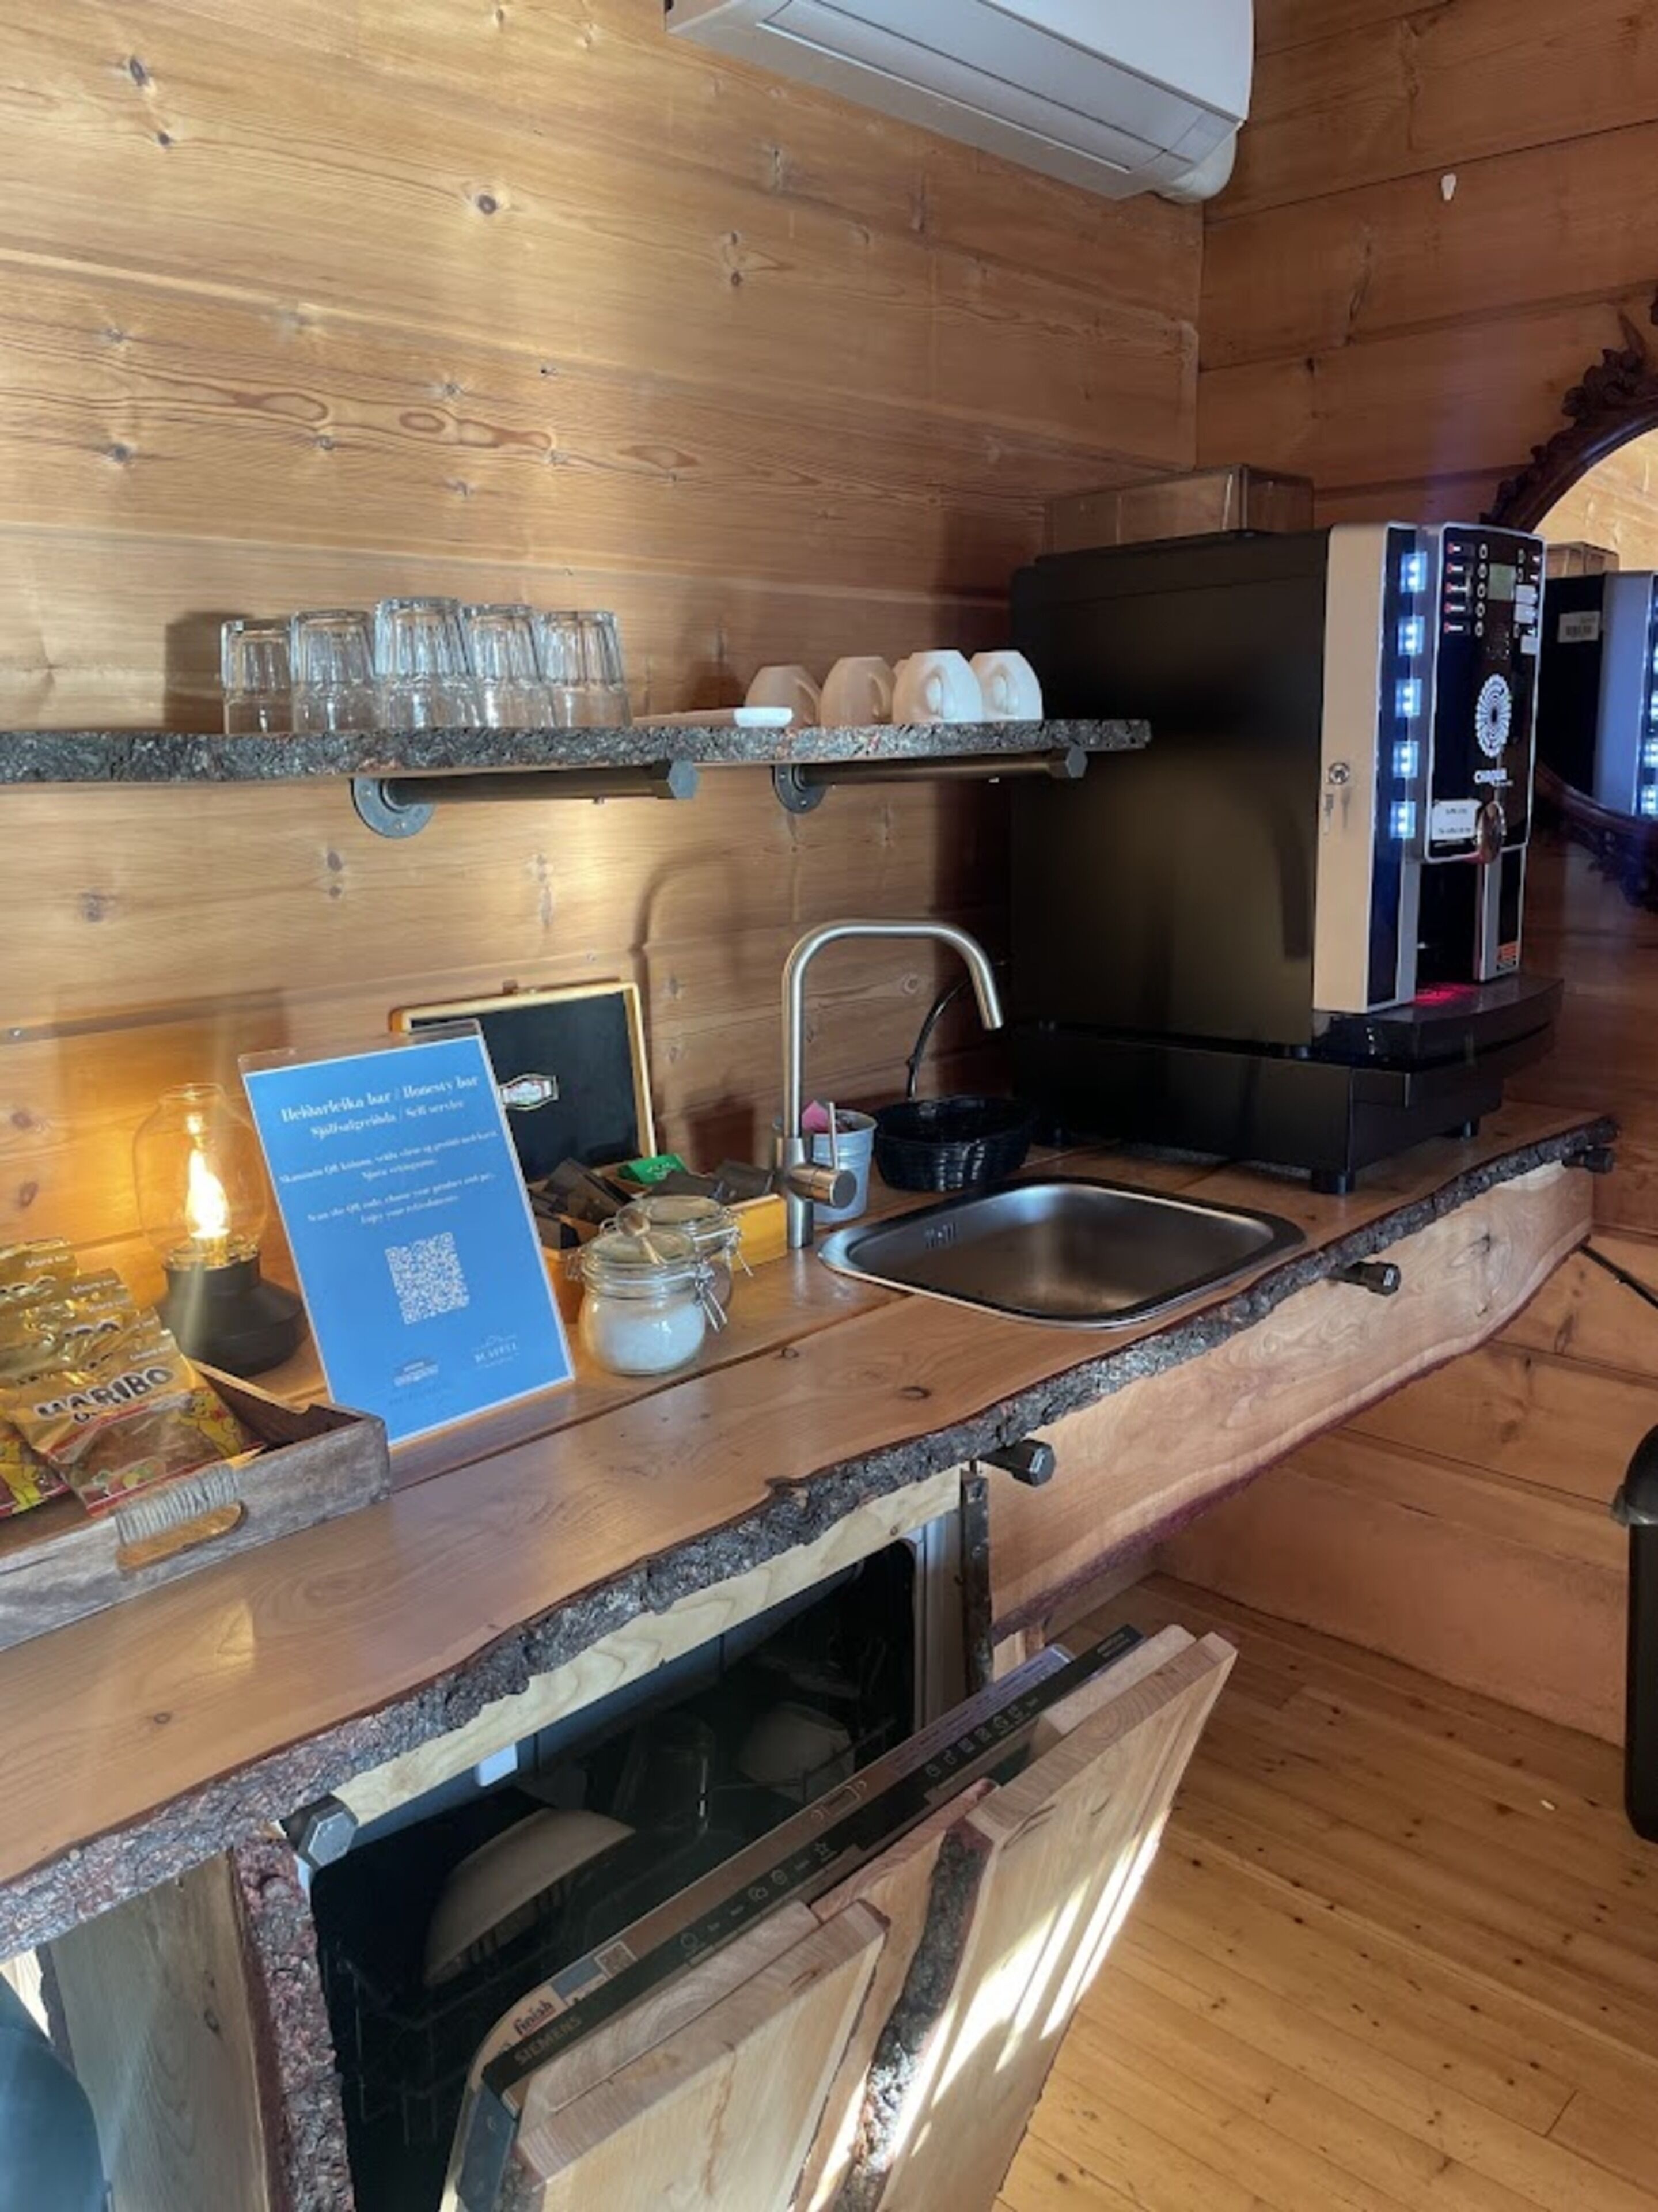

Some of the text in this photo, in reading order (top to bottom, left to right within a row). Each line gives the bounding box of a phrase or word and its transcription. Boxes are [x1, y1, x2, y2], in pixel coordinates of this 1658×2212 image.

[367, 1092, 391, 1105] bar
[403, 1081, 453, 1099] Honesty
[455, 1075, 479, 1089] bar
[405, 1104, 427, 1118] Self
[513, 1998, 556, 2037] finish
[513, 2016, 582, 2065] SIEMENS
